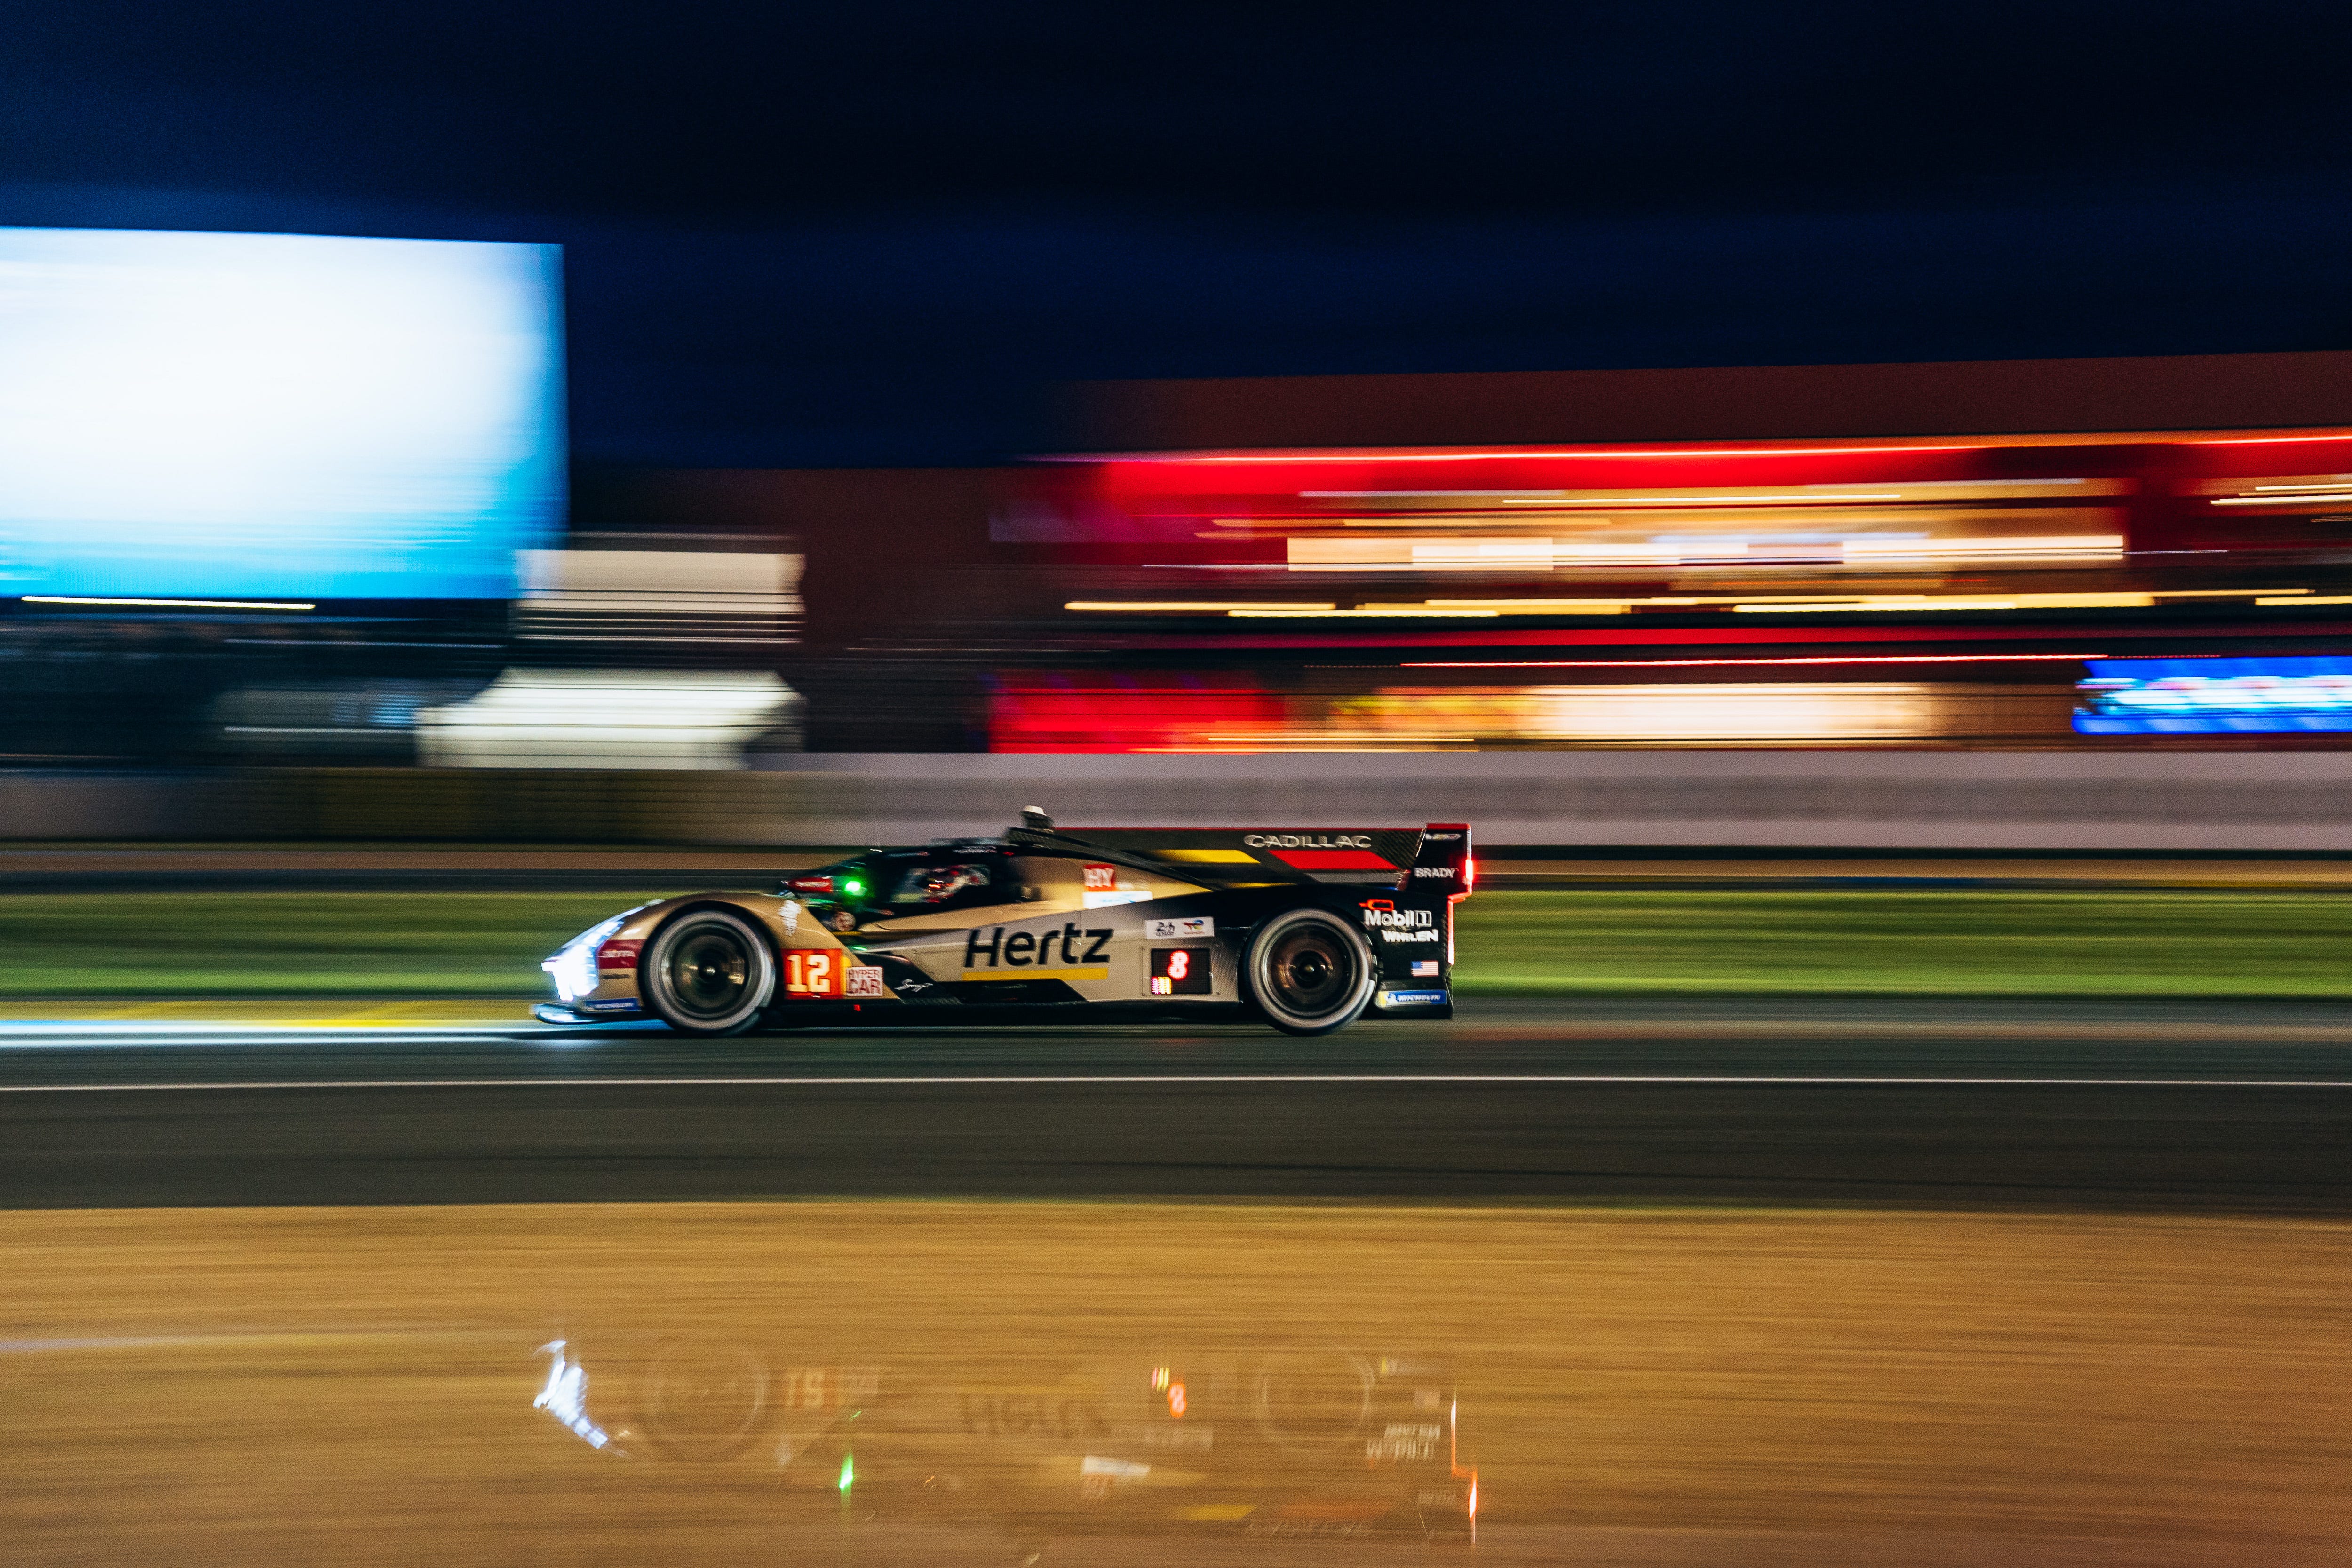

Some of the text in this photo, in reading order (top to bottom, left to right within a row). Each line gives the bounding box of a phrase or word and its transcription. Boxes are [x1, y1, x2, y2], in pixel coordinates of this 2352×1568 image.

[1244, 835, 1372, 848] CADILLAC
[1414, 868, 1455, 878] BRADY
[1364, 909, 1414, 927] Mobil
[963, 922, 1114, 968] Hertz
[787, 954, 830, 993] 12
[848, 969, 880, 978] HYPER
[1167, 950, 1190, 981] 8
[848, 979, 881, 994] CAR
